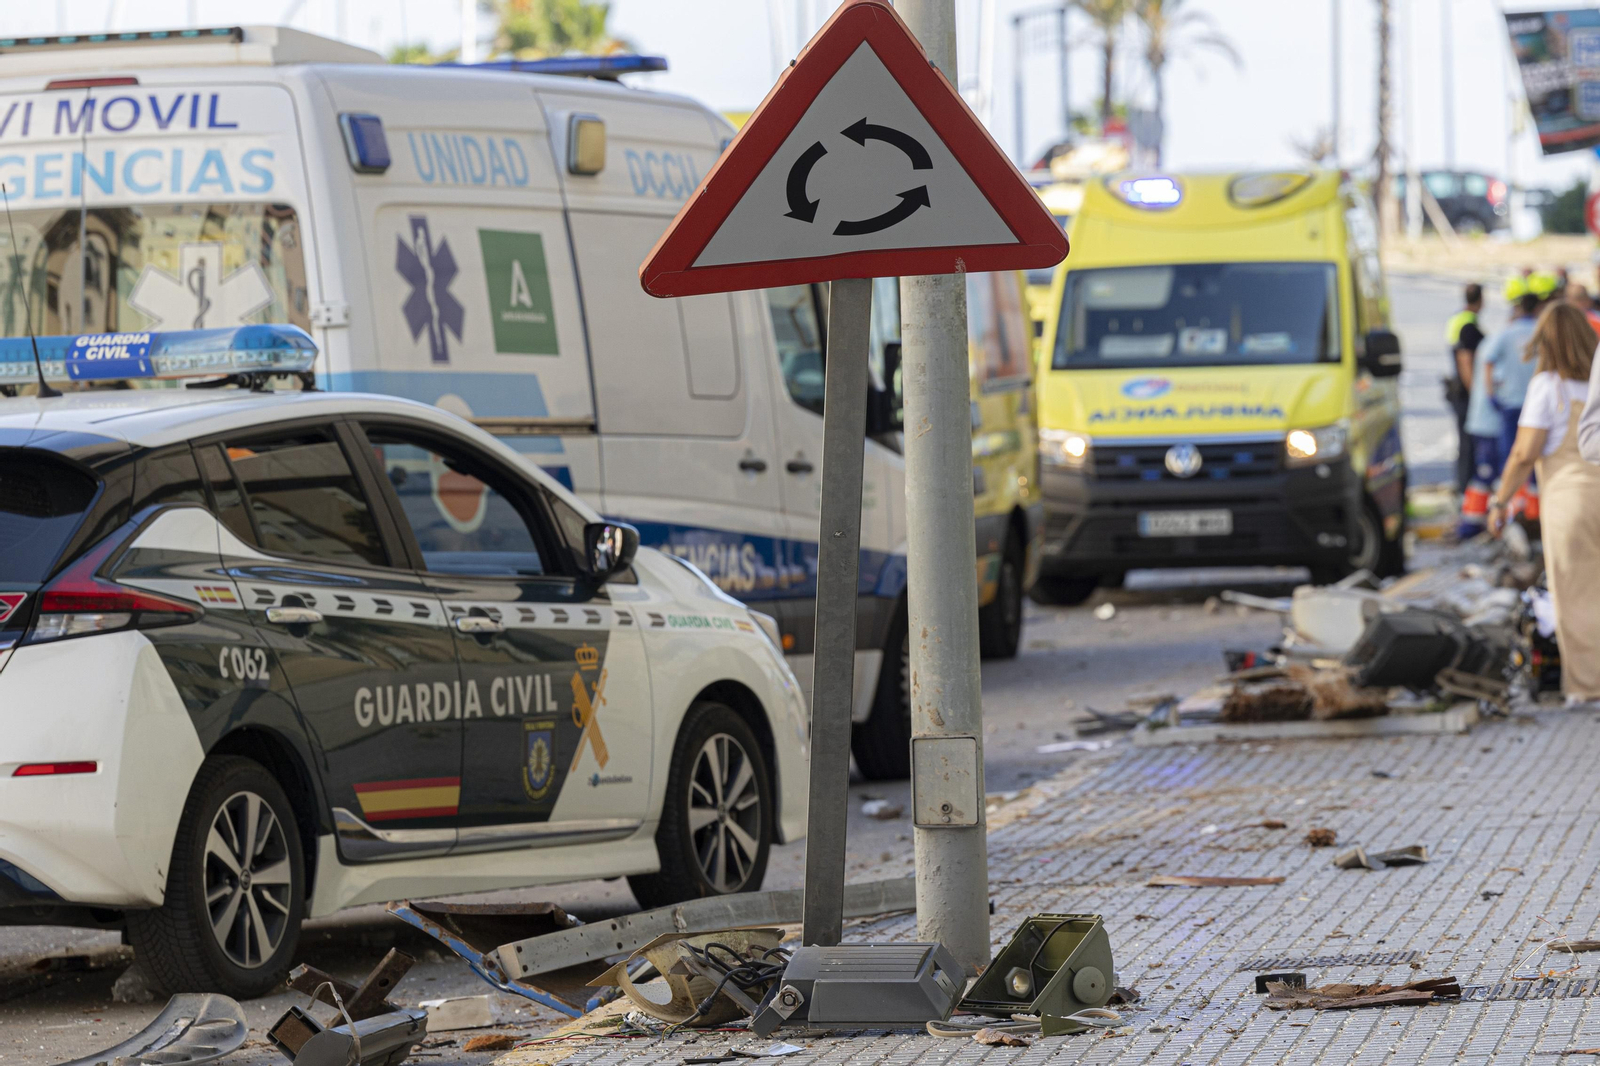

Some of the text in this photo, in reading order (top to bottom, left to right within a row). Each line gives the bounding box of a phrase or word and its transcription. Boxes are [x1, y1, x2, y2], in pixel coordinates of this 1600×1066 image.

[53, 93, 239, 135] MOVIL
[407, 131, 529, 187] UNIDAD
[75, 333, 150, 347] GUARDIA
[85, 345, 131, 360] CIVIL
[667, 613, 735, 630] GUARDIA CIVIL
[354, 674, 558, 727] GUARDIA CIVIL
